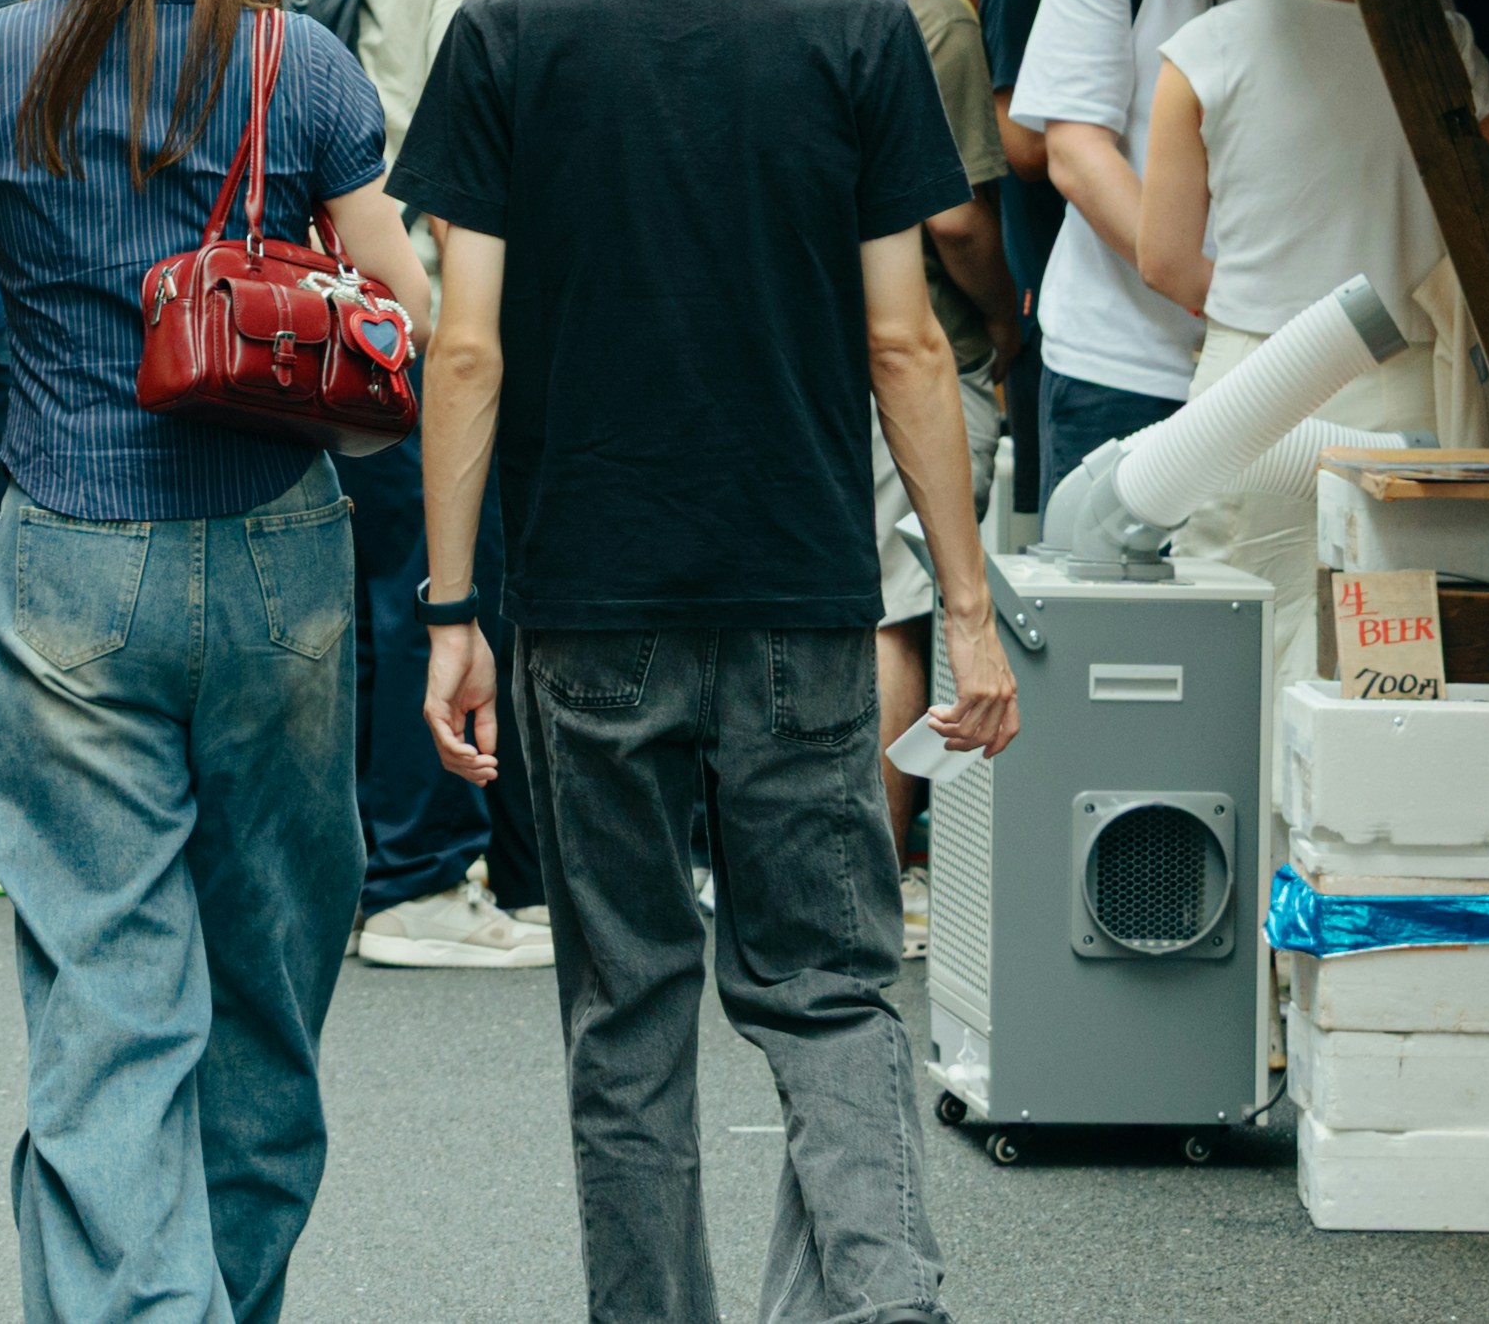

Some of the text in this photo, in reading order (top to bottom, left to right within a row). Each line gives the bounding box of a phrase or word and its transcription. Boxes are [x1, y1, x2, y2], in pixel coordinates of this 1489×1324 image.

[1338, 581, 1379, 619] 生
[1358, 617, 1436, 647] BEER
[1354, 667, 1439, 700] 700円
